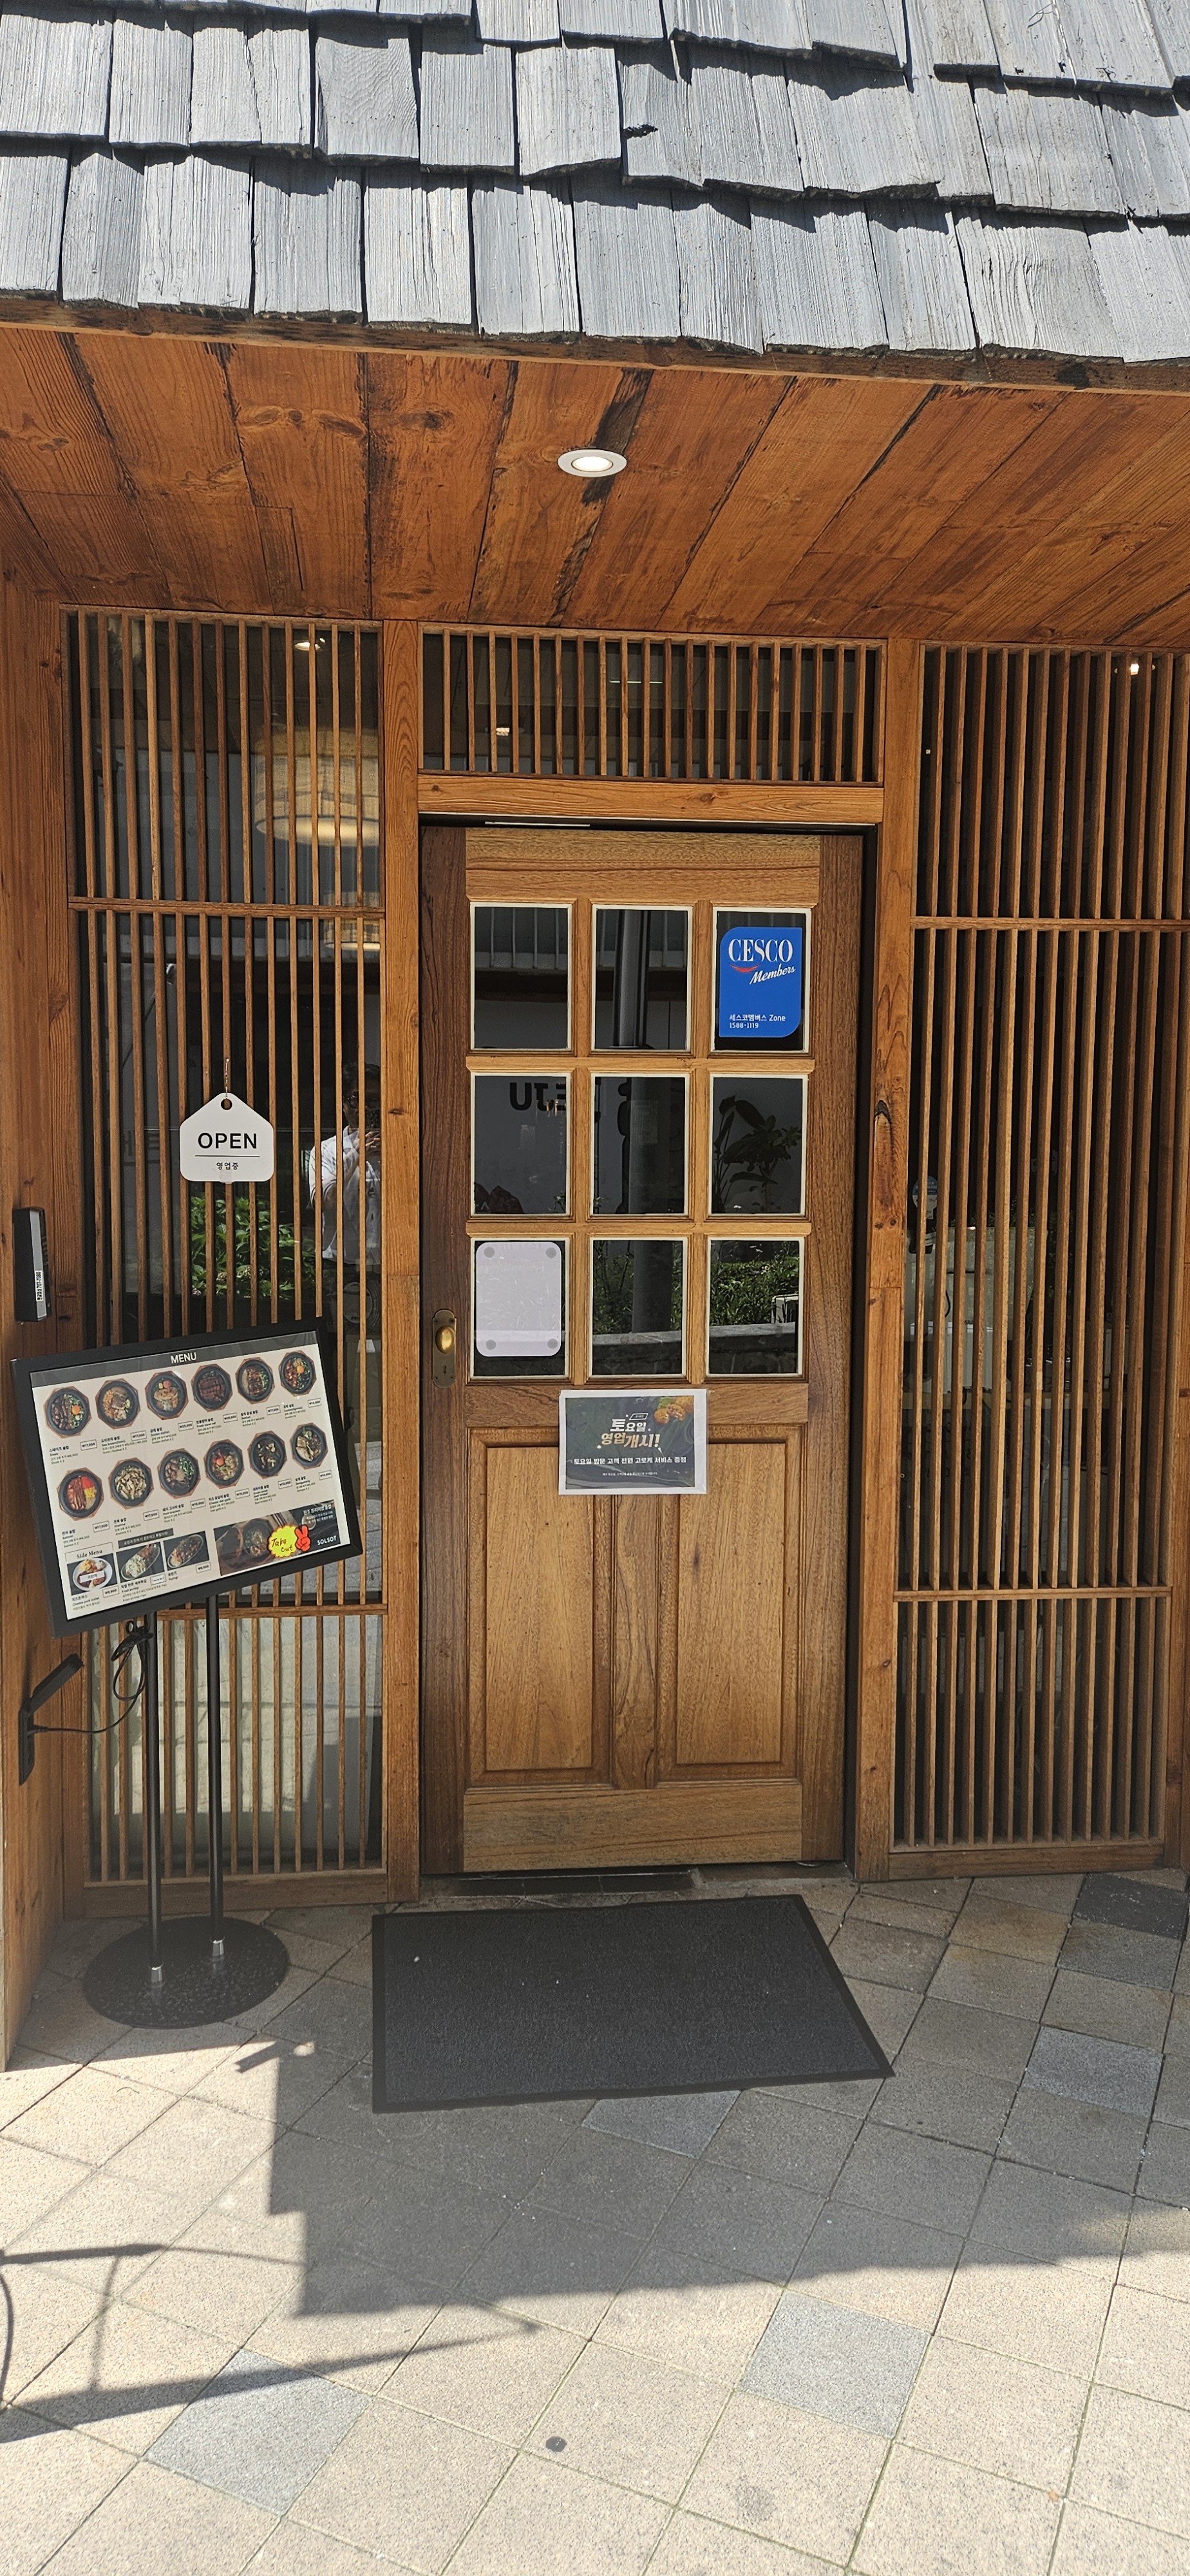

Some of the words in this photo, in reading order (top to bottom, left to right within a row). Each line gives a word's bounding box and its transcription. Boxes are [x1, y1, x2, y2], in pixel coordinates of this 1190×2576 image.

[728, 938, 793, 962] CESCO
[749, 963, 796, 985] Members
[198, 1132, 257, 1149] OPEN
[216, 1162, 239, 1170] 영업중
[171, 1352, 197, 1364] MENU
[610, 1419, 647, 1432] 토요일
[601, 1432, 660, 1448] 영업개시!
[271, 1538, 287, 1548] Take
[317, 1535, 337, 1546] SOLSOT
[88, 1548, 102, 1557] Menu
